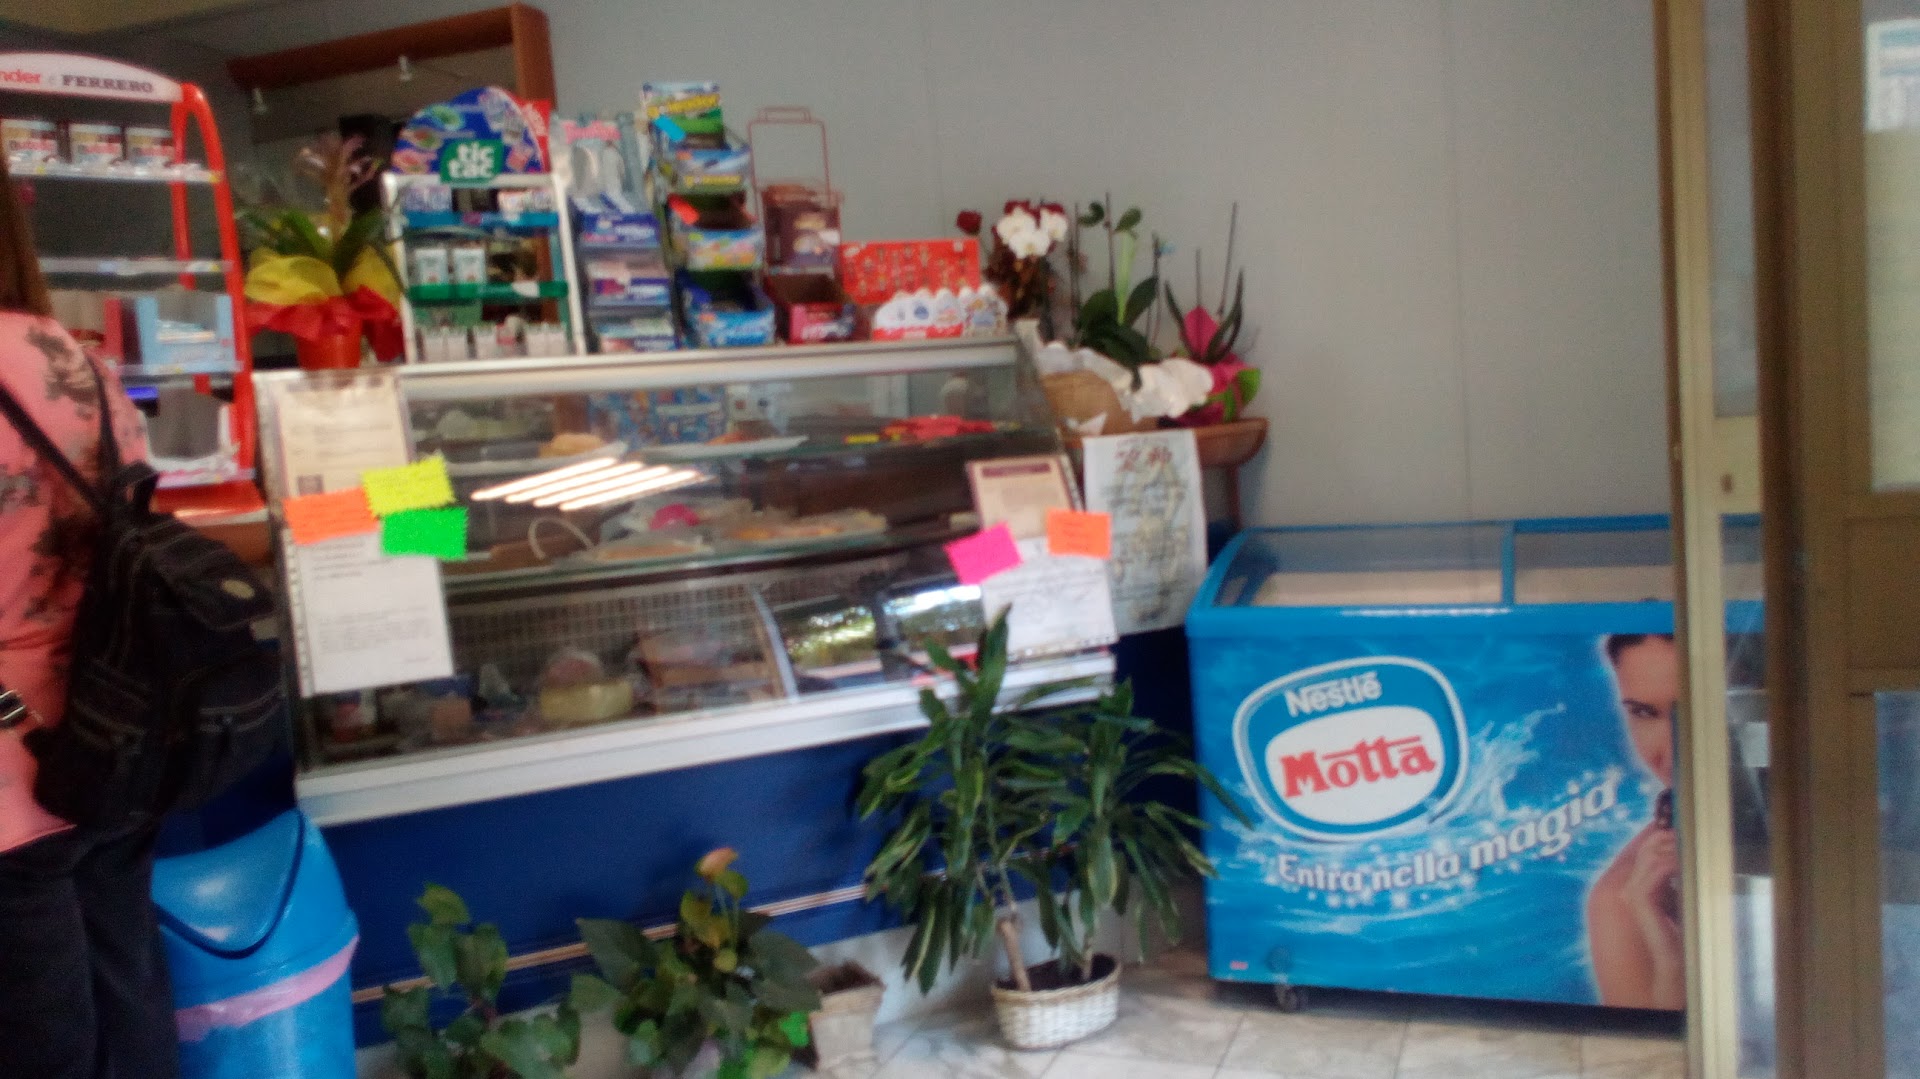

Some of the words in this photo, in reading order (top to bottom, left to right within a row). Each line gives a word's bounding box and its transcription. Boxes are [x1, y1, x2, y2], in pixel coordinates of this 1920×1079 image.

[62, 74, 153, 93] FERRERO
[456, 141, 495, 161] tic
[447, 158, 494, 179] tac
[1285, 671, 1382, 717] Nestlé
[1280, 735, 1437, 799] Motta
[1278, 853, 1363, 893] Entra
[1371, 851, 1461, 889] nella
[1469, 775, 1620, 869] magia
